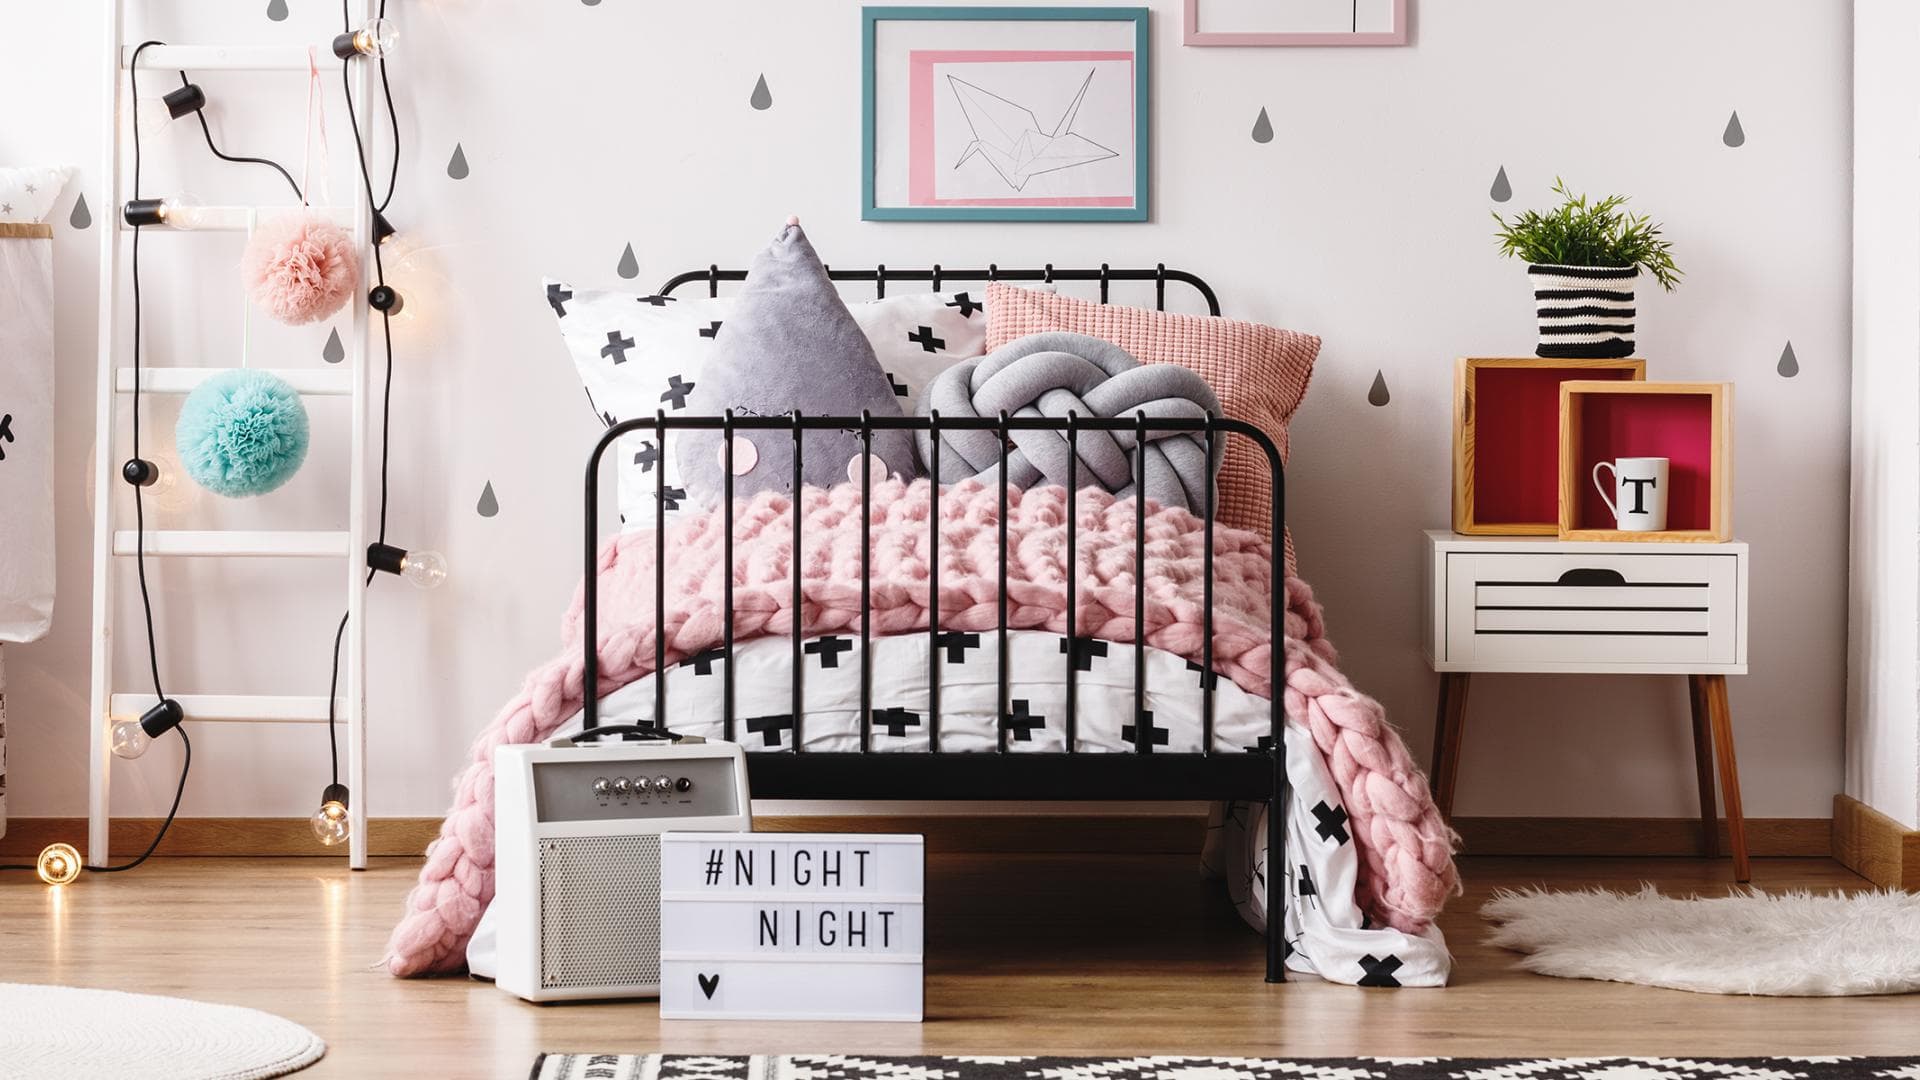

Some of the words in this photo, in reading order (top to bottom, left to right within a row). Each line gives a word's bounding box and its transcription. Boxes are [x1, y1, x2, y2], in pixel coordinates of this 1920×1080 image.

[1622, 476, 1656, 514] T
[705, 849, 870, 887] #NIGHT
[759, 909, 895, 948] NIGHT
